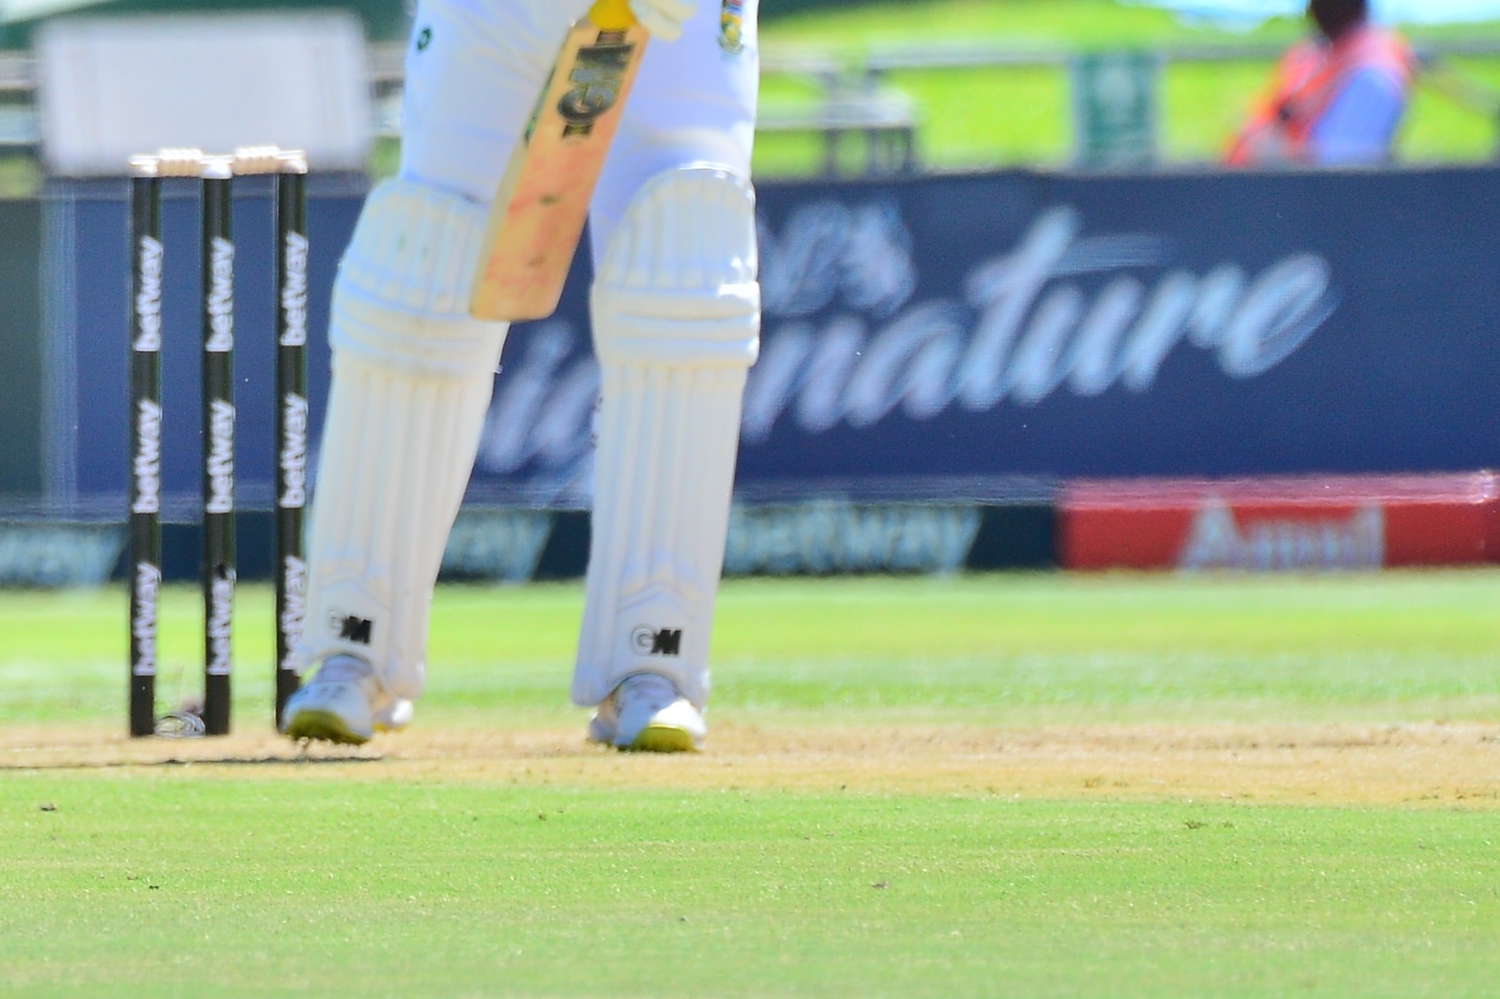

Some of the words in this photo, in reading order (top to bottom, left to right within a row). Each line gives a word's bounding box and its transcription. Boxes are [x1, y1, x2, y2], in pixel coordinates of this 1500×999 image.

[133, 235, 164, 352] betway
[205, 236, 235, 352] betway
[279, 230, 309, 346] betway
[132, 398, 163, 513] betway
[206, 398, 236, 513] betway
[279, 392, 309, 508] betway
[132, 560, 162, 675] betway
